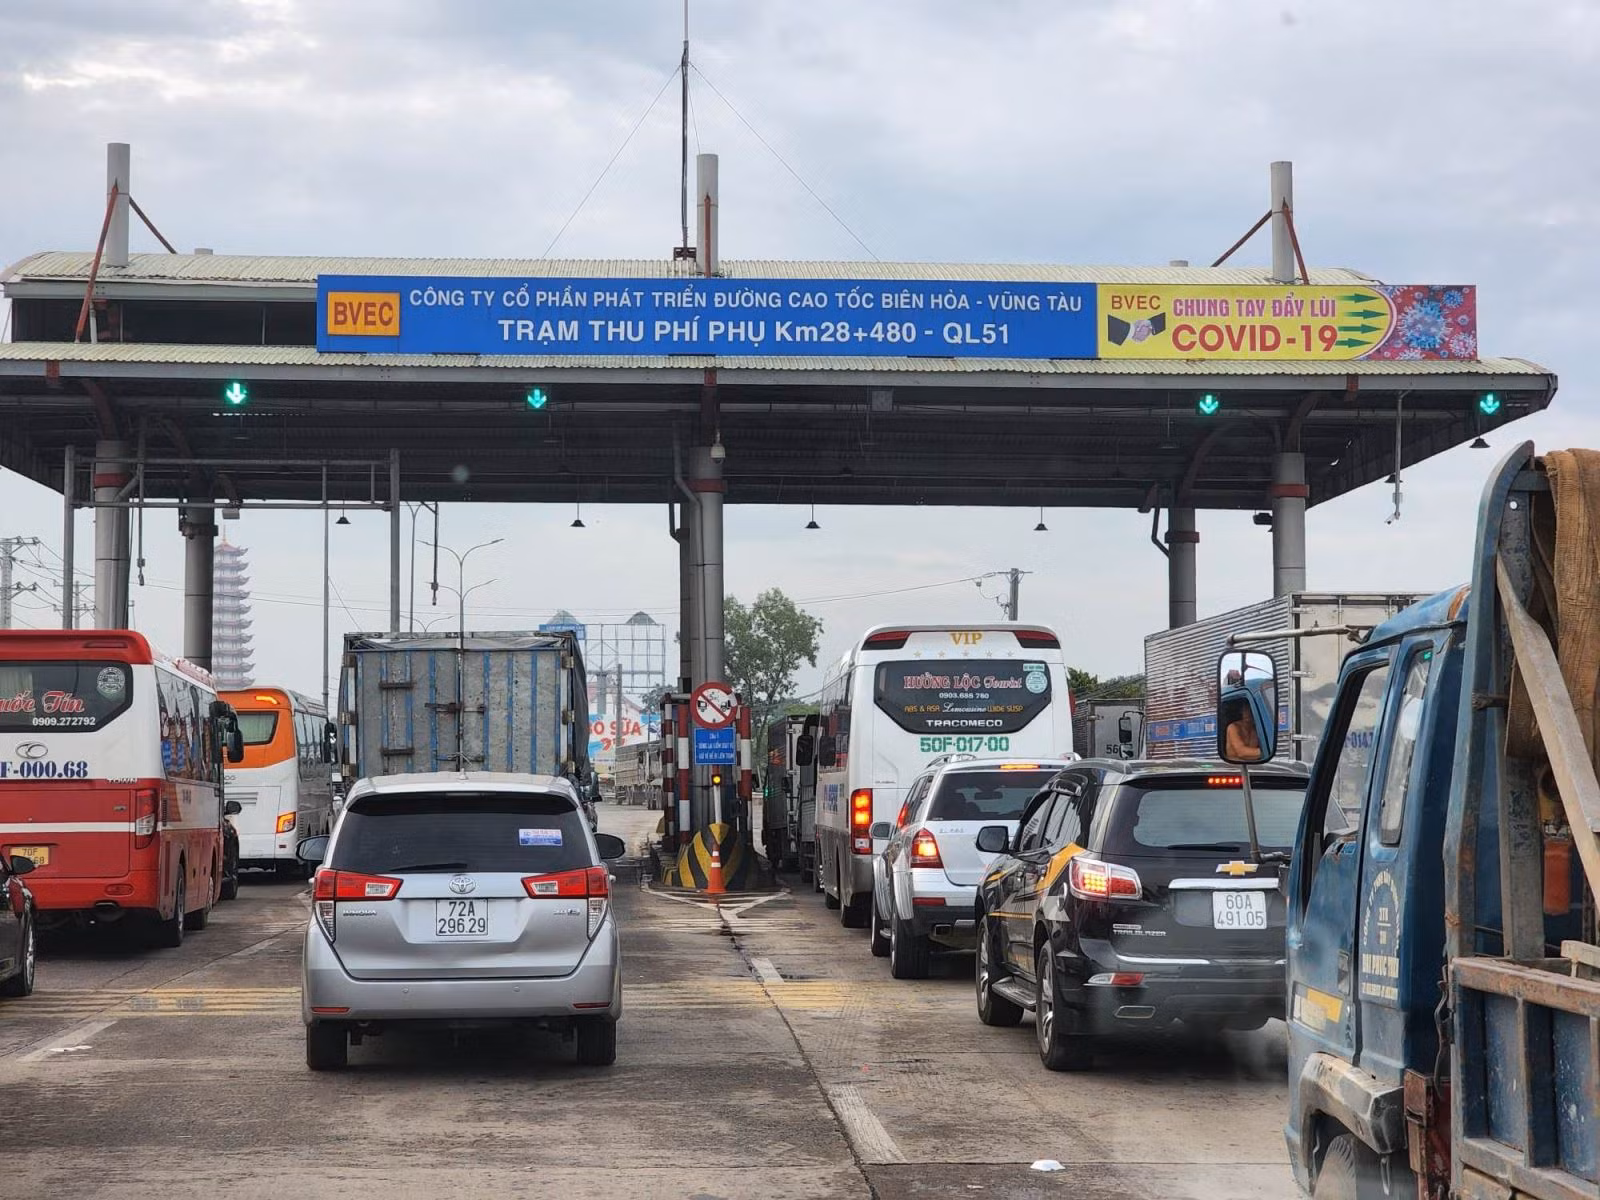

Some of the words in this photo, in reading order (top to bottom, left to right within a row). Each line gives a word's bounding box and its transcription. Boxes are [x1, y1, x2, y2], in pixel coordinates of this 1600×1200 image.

[409, 286, 464, 306] CÔNG
[471, 291, 495, 307] TY
[502, 283, 530, 307] CỔ
[536, 285, 587, 307] PHẦN
[593, 288, 644, 308] PHÁT
[652, 284, 706, 308] TRIỂN
[714, 287, 782, 308] ĐƯỜNG
[788, 292, 828, 308] CAO
[835, 286, 874, 309] TỐC
[881, 289, 924, 309] BIÊN
[930, 289, 970, 310] HÒA
[988, 291, 1040, 310] VŨNG
[1046, 292, 1082, 312] TÀU
[1111, 295, 1161, 310] BVEC
[1173, 299, 1230, 317] CHUNG
[1236, 299, 1266, 317] TAY
[1272, 292, 1304, 317] ĐẨY
[1310, 296, 1336, 317] LÙI
[334, 302, 394, 326] BVEC
[498, 320, 579, 345] TRẠM
[588, 320, 644, 342] THU
[654, 315, 700, 342] PHÍ
[709, 321, 765, 347] PHỤ
[775, 321, 917, 343] Km28+480
[942, 322, 1009, 344] QL51
[950, 632, 982, 645] VIP
[953, 673, 981, 691] LỘC
[32, 716, 96, 726] 0909.272792
[926, 719, 1003, 727] TRACOMECO
[22, 848, 38, 856] 70F
[448, 901, 476, 917] 72A
[1226, 895, 1253, 909] 60A
[438, 918, 486, 934] 296.29
[1217, 911, 1264, 926] 491.05
